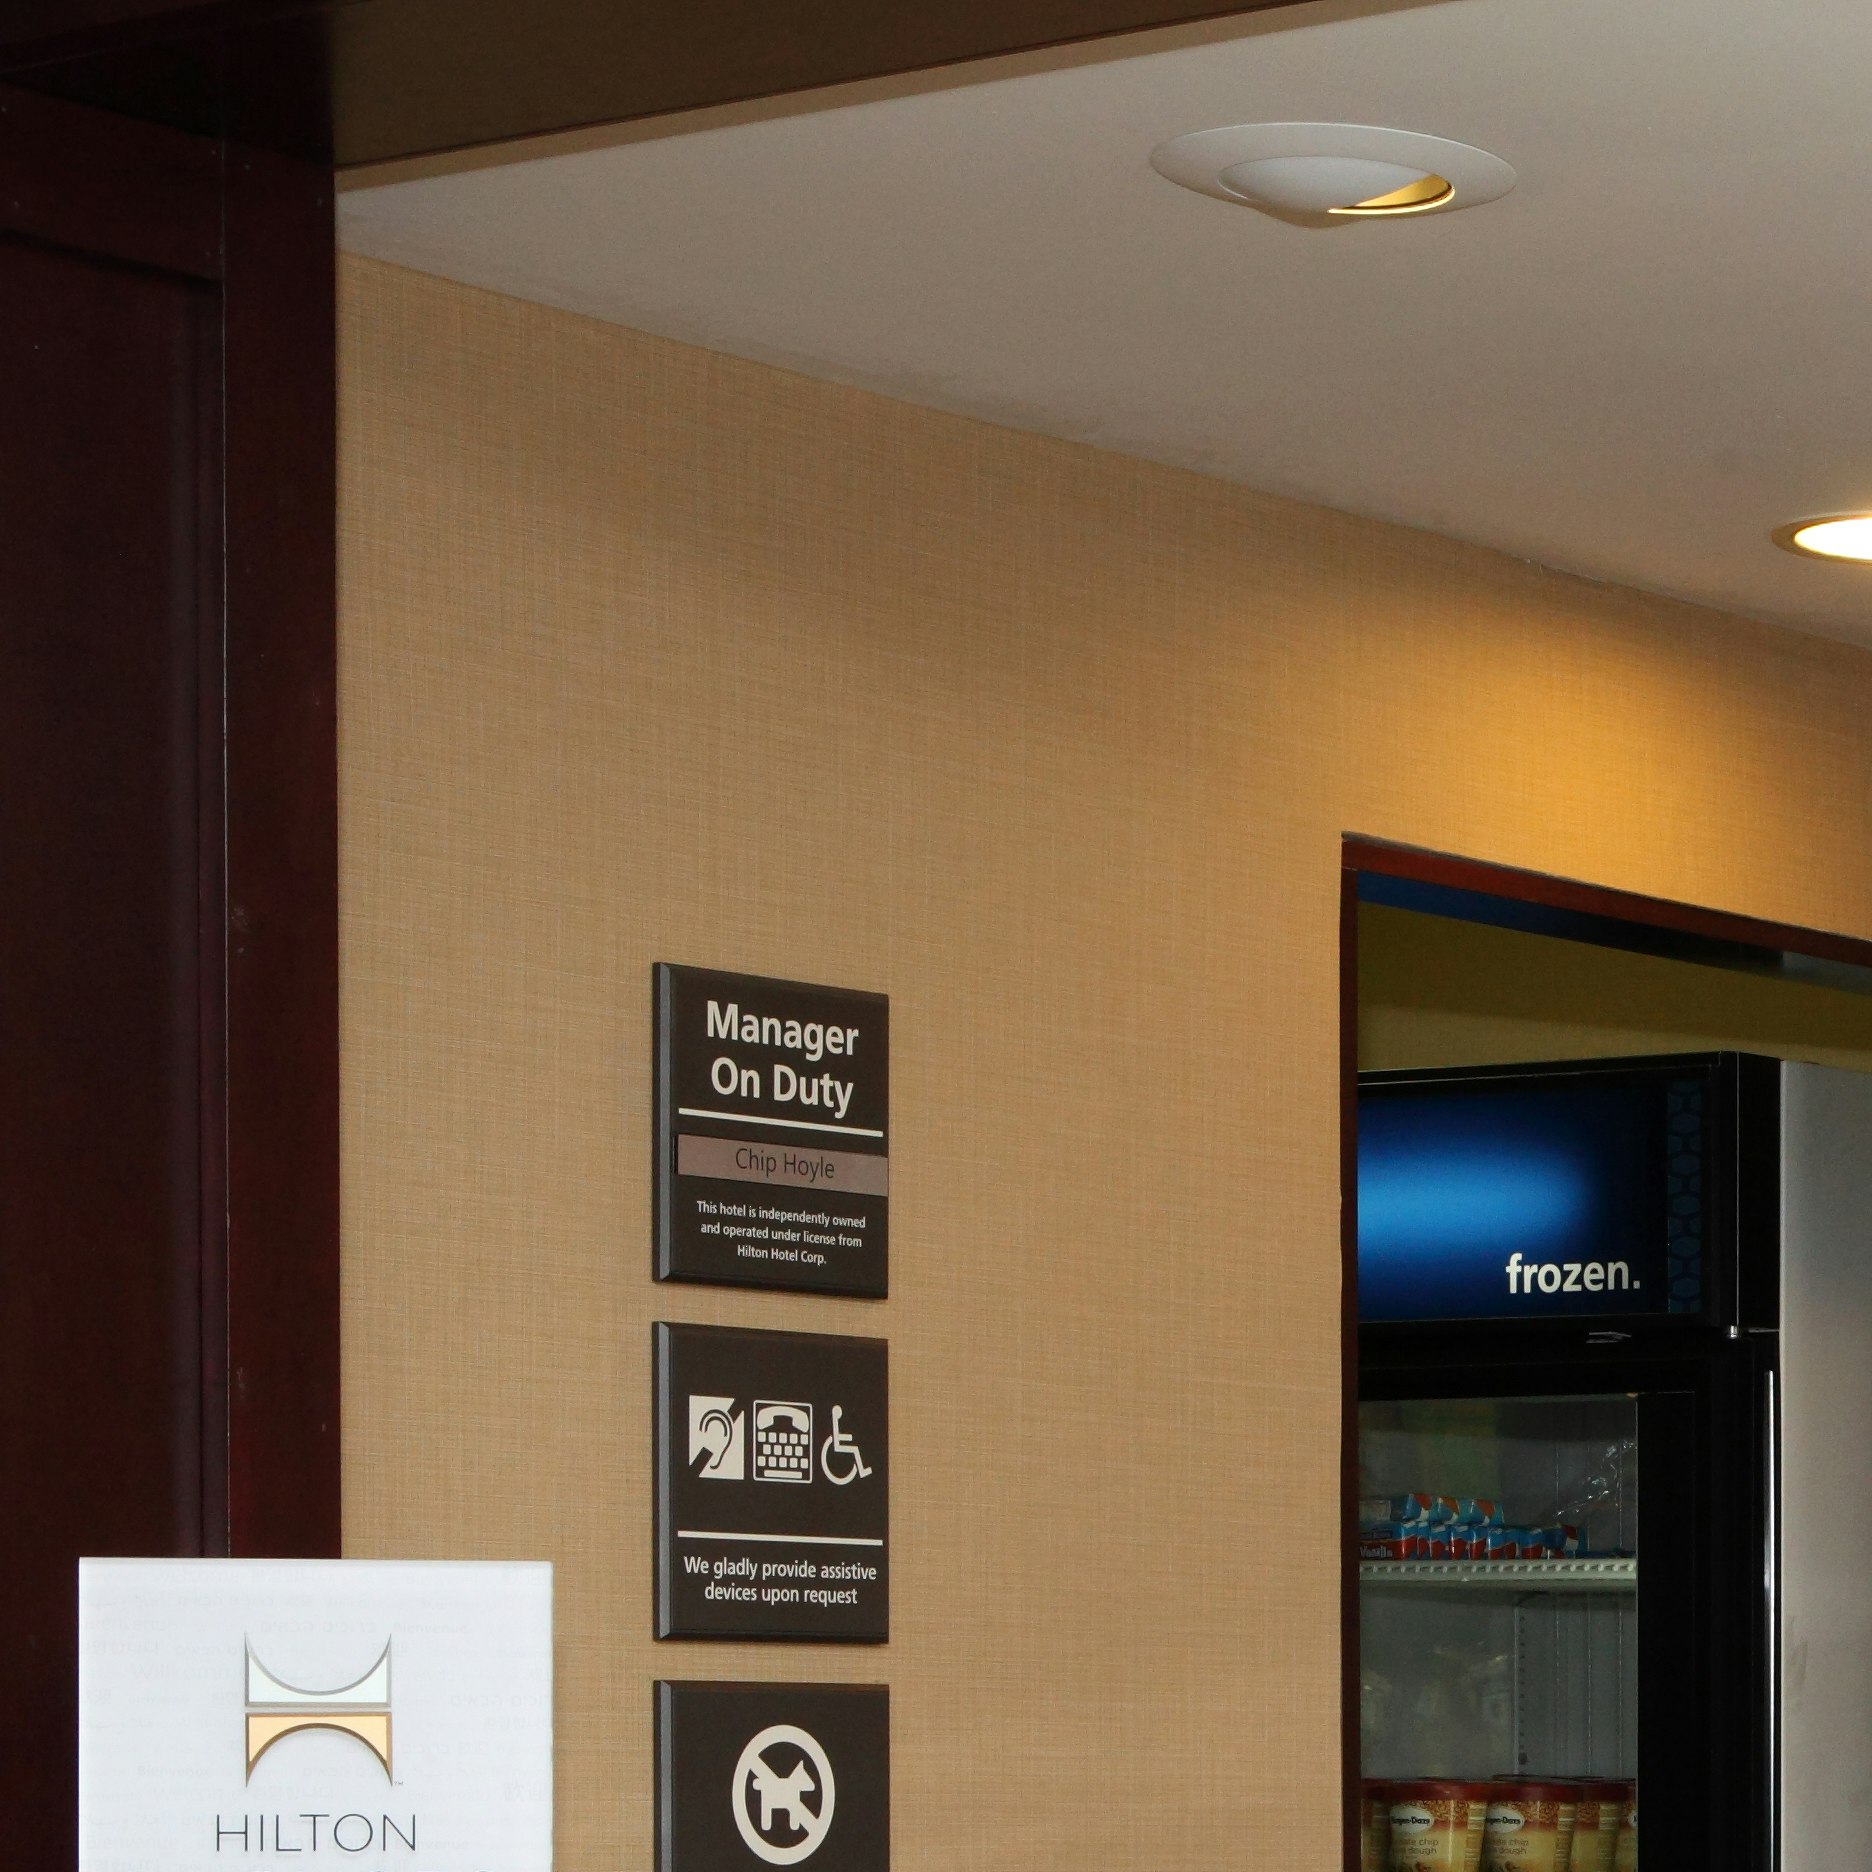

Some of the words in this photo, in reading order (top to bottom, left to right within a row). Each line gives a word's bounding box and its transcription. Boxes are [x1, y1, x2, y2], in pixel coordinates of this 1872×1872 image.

[706, 999, 859, 1061] Manager
[711, 1057, 760, 1098] On
[773, 1064, 854, 1119] Duty
[735, 1148, 777, 1176] Chip
[783, 1153, 835, 1183] Hoyle
[696, 1200, 717, 1215] This
[719, 1203, 746, 1218] hotel
[749, 1205, 757, 1219] is
[758, 1206, 830, 1228] independently
[832, 1215, 866, 1229] owned
[701, 1222, 720, 1235] and
[723, 1225, 769, 1241] operated
[772, 1229, 801, 1243] under
[803, 1231, 836, 1246] license
[838, 1233, 862, 1248] from
[737, 1244, 768, 1260] Hilton
[771, 1248, 798, 1263] Hotel
[801, 1250, 827, 1266] Corp.
[1505, 1253, 1641, 1295] frozen.
[684, 1556, 709, 1574] We
[713, 1557, 759, 1580] gladly
[762, 1560, 816, 1580] provide
[821, 1562, 877, 1581] assistive
[705, 1582, 757, 1601] devices
[762, 1586, 799, 1605] upon
[804, 1588, 858, 1607] request
[216, 1813, 416, 1852] HILTON
